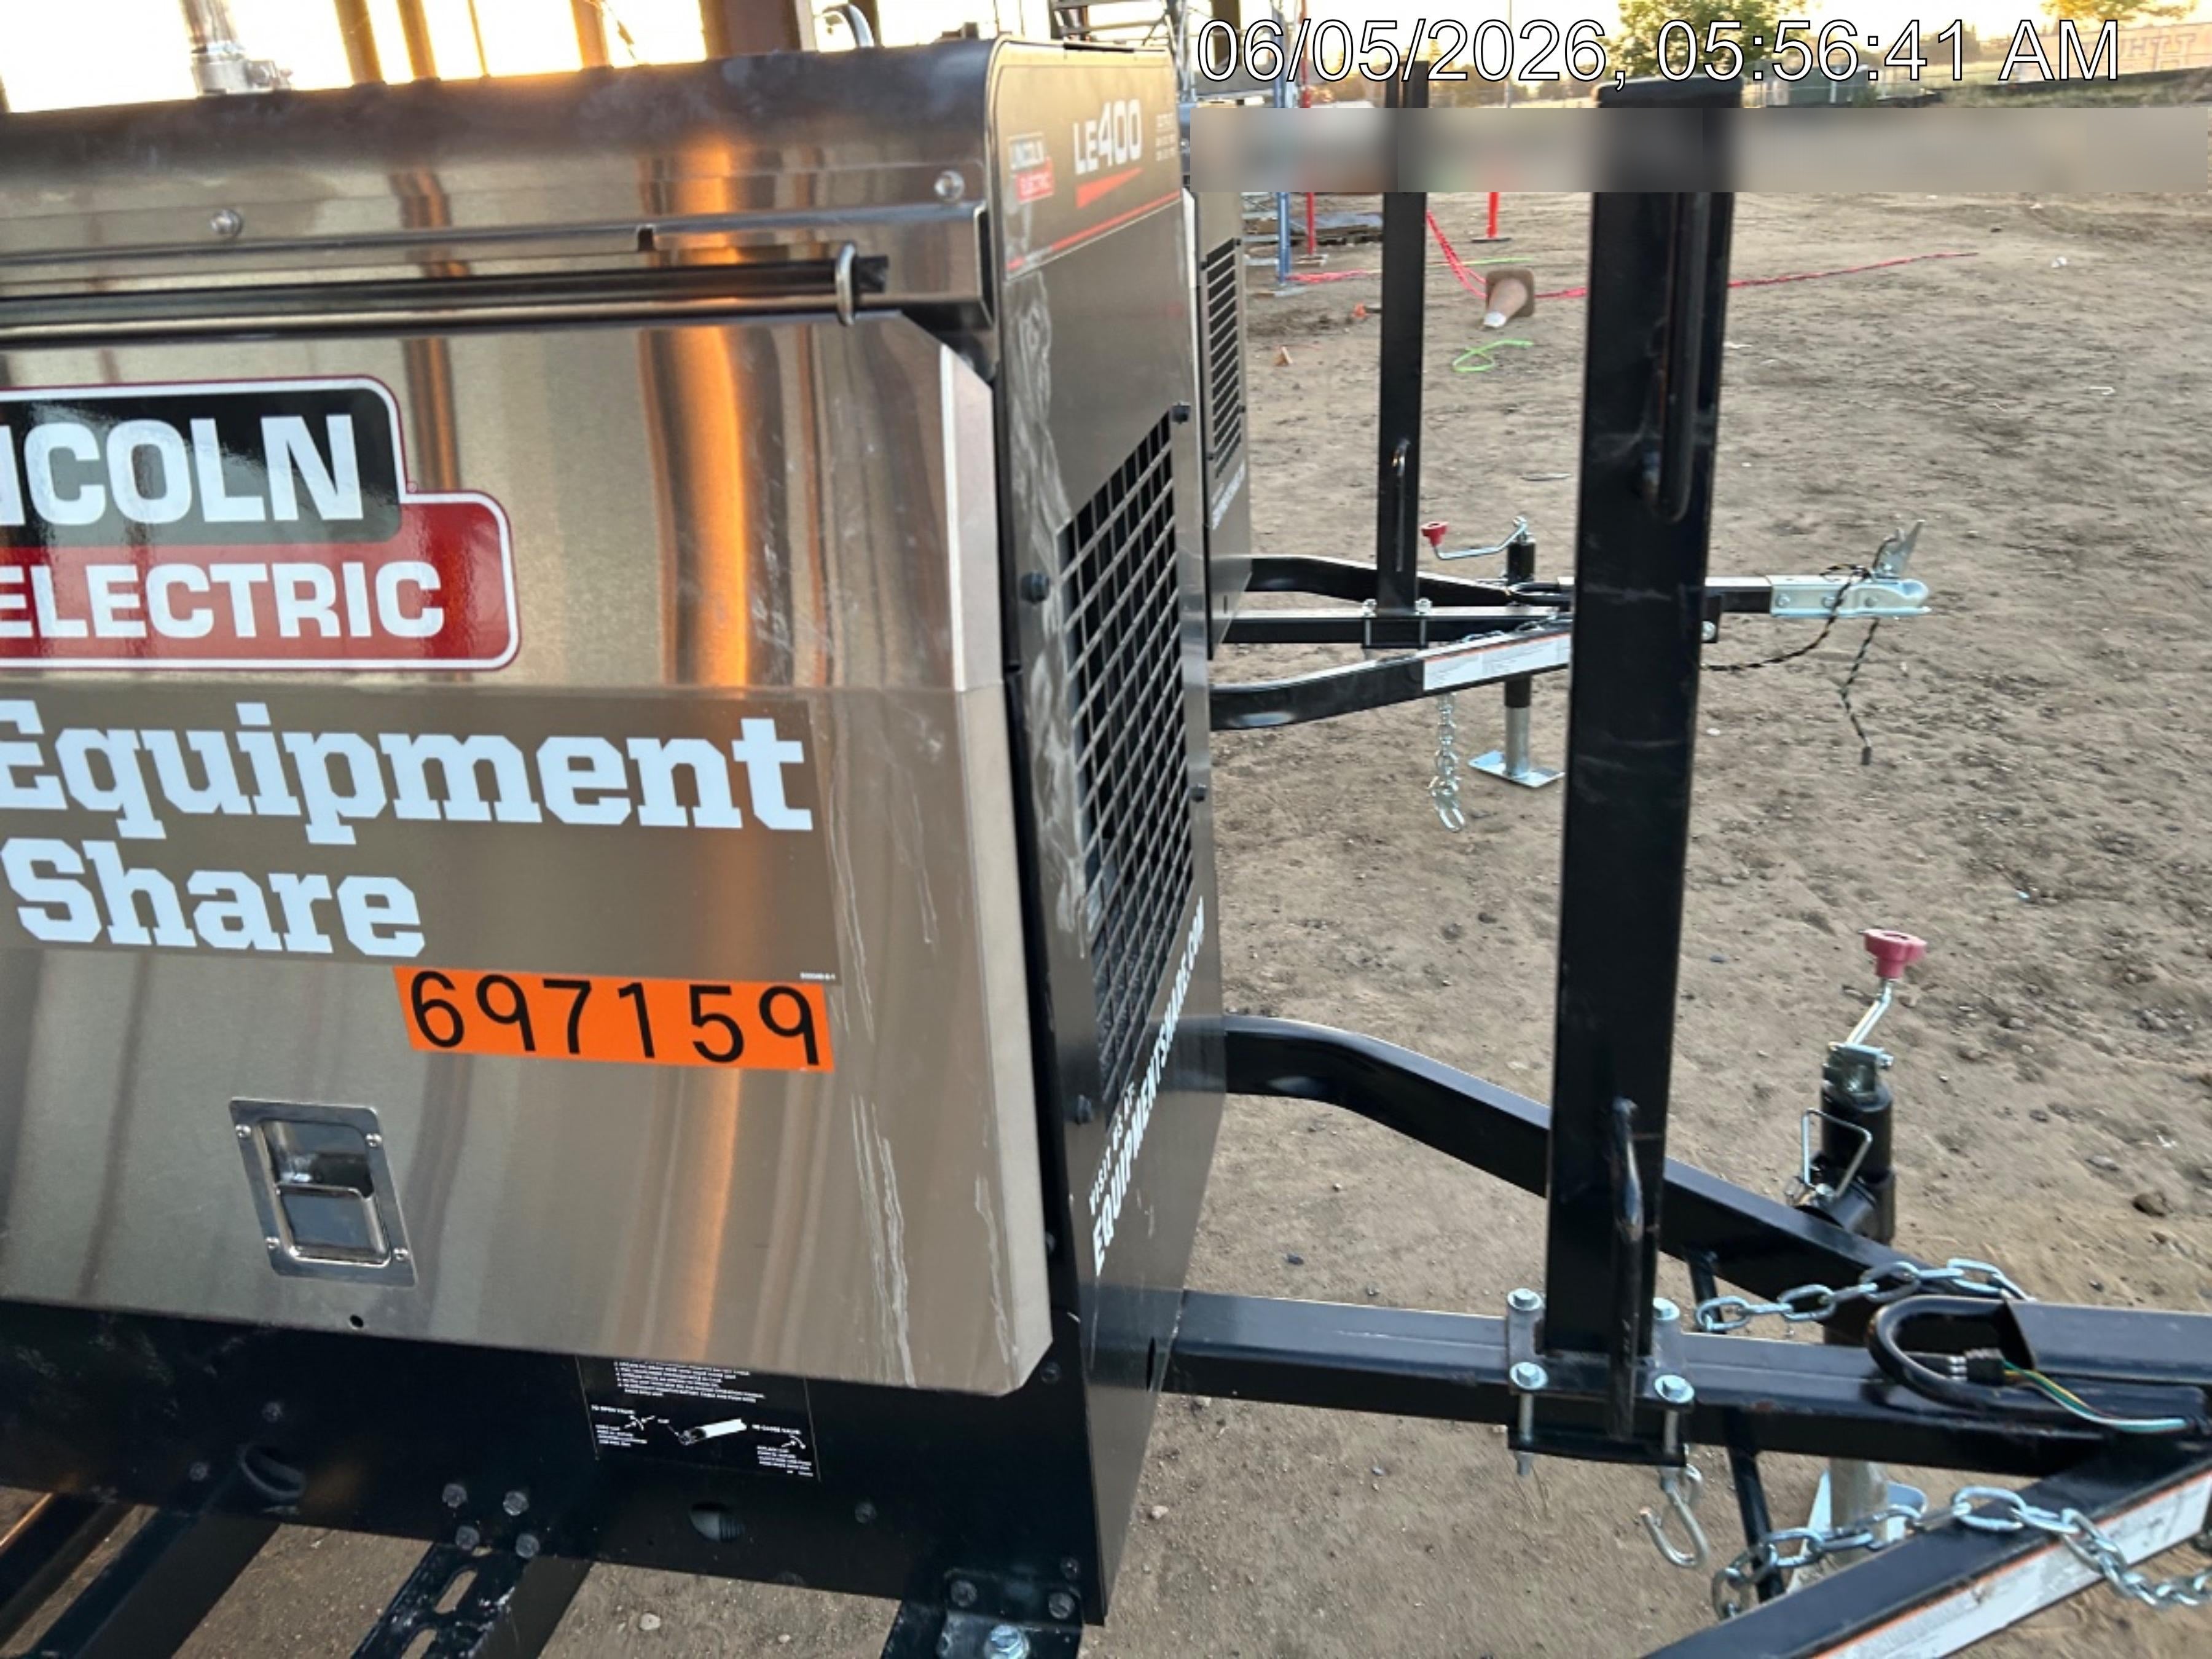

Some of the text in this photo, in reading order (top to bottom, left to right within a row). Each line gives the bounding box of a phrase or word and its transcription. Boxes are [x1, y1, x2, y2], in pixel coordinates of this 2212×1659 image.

[1073, 98, 1142, 176] LE400
[0, 700, 813, 845] Equipment
[1, 837, 425, 958] Share
[410, 970, 820, 1066] 697159
